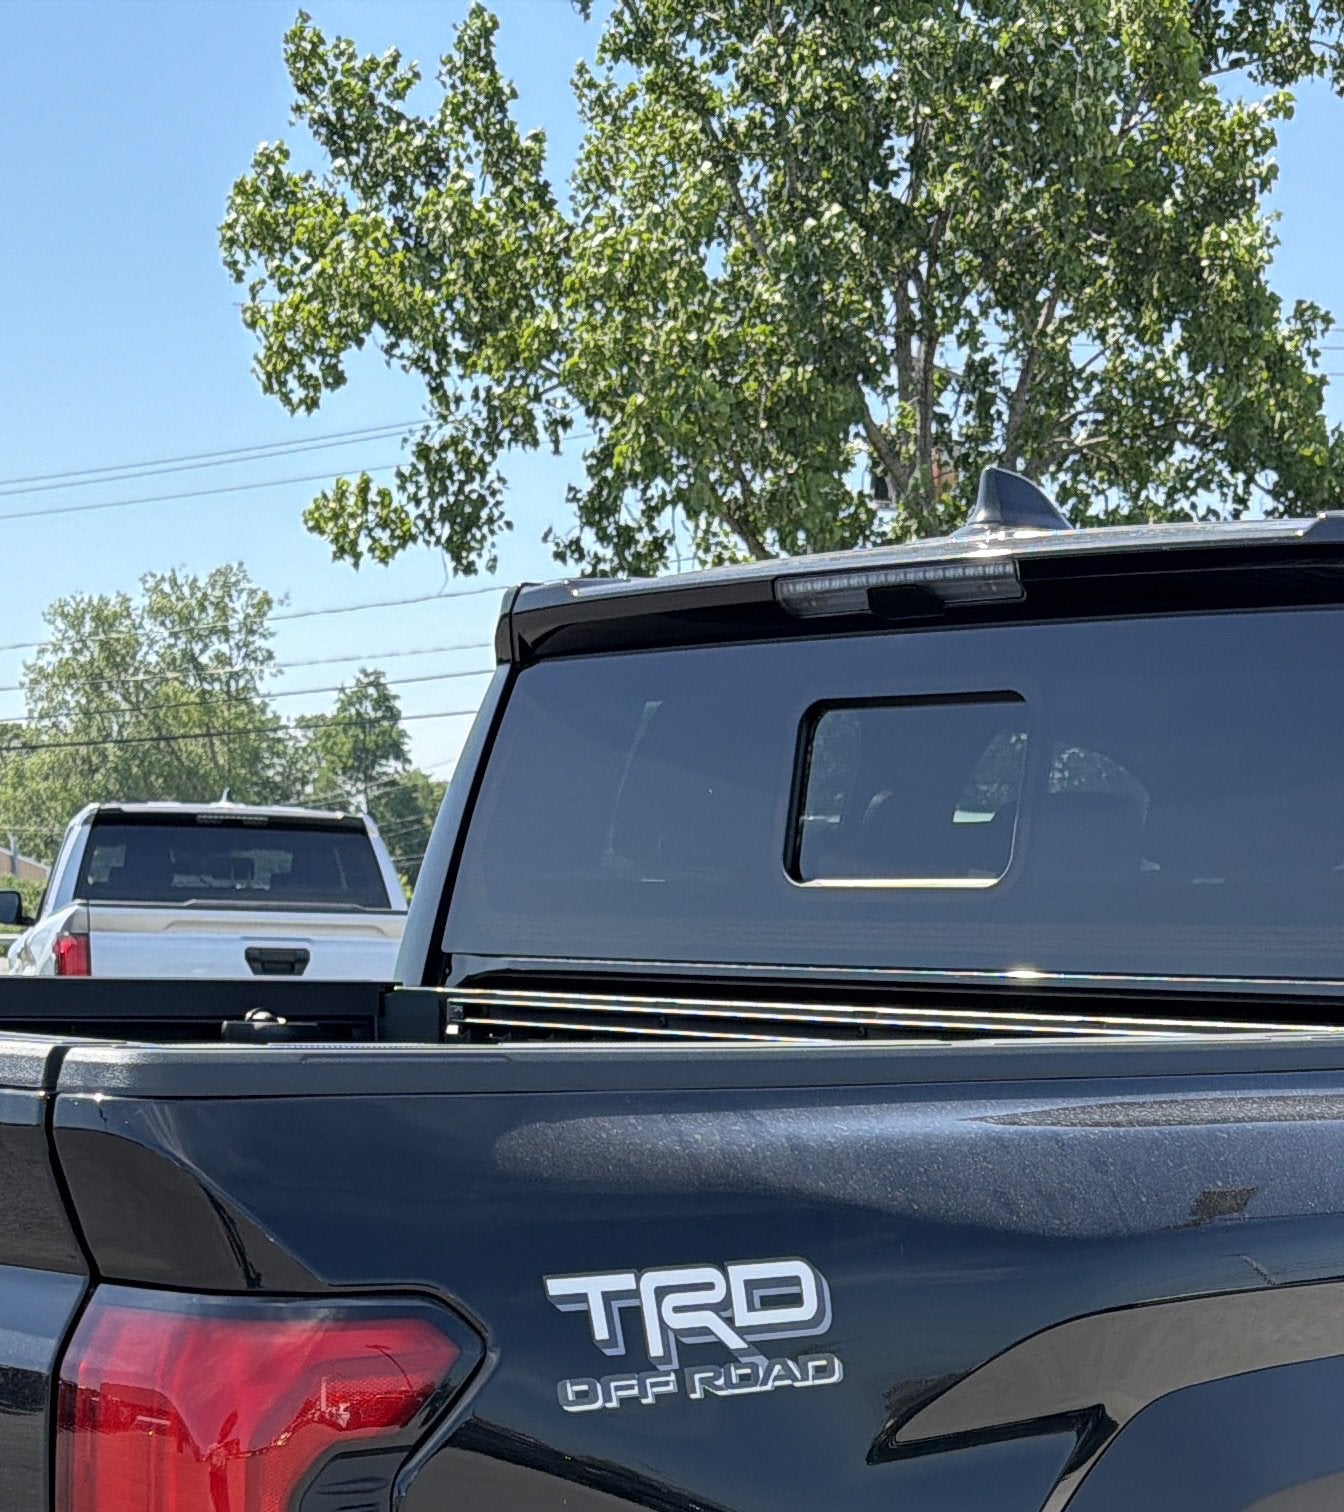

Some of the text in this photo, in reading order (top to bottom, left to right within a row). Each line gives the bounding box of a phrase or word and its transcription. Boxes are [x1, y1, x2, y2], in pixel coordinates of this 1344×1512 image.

[544, 1256, 832, 1370] TRD
[557, 1353, 844, 1412] OFF ROAD
